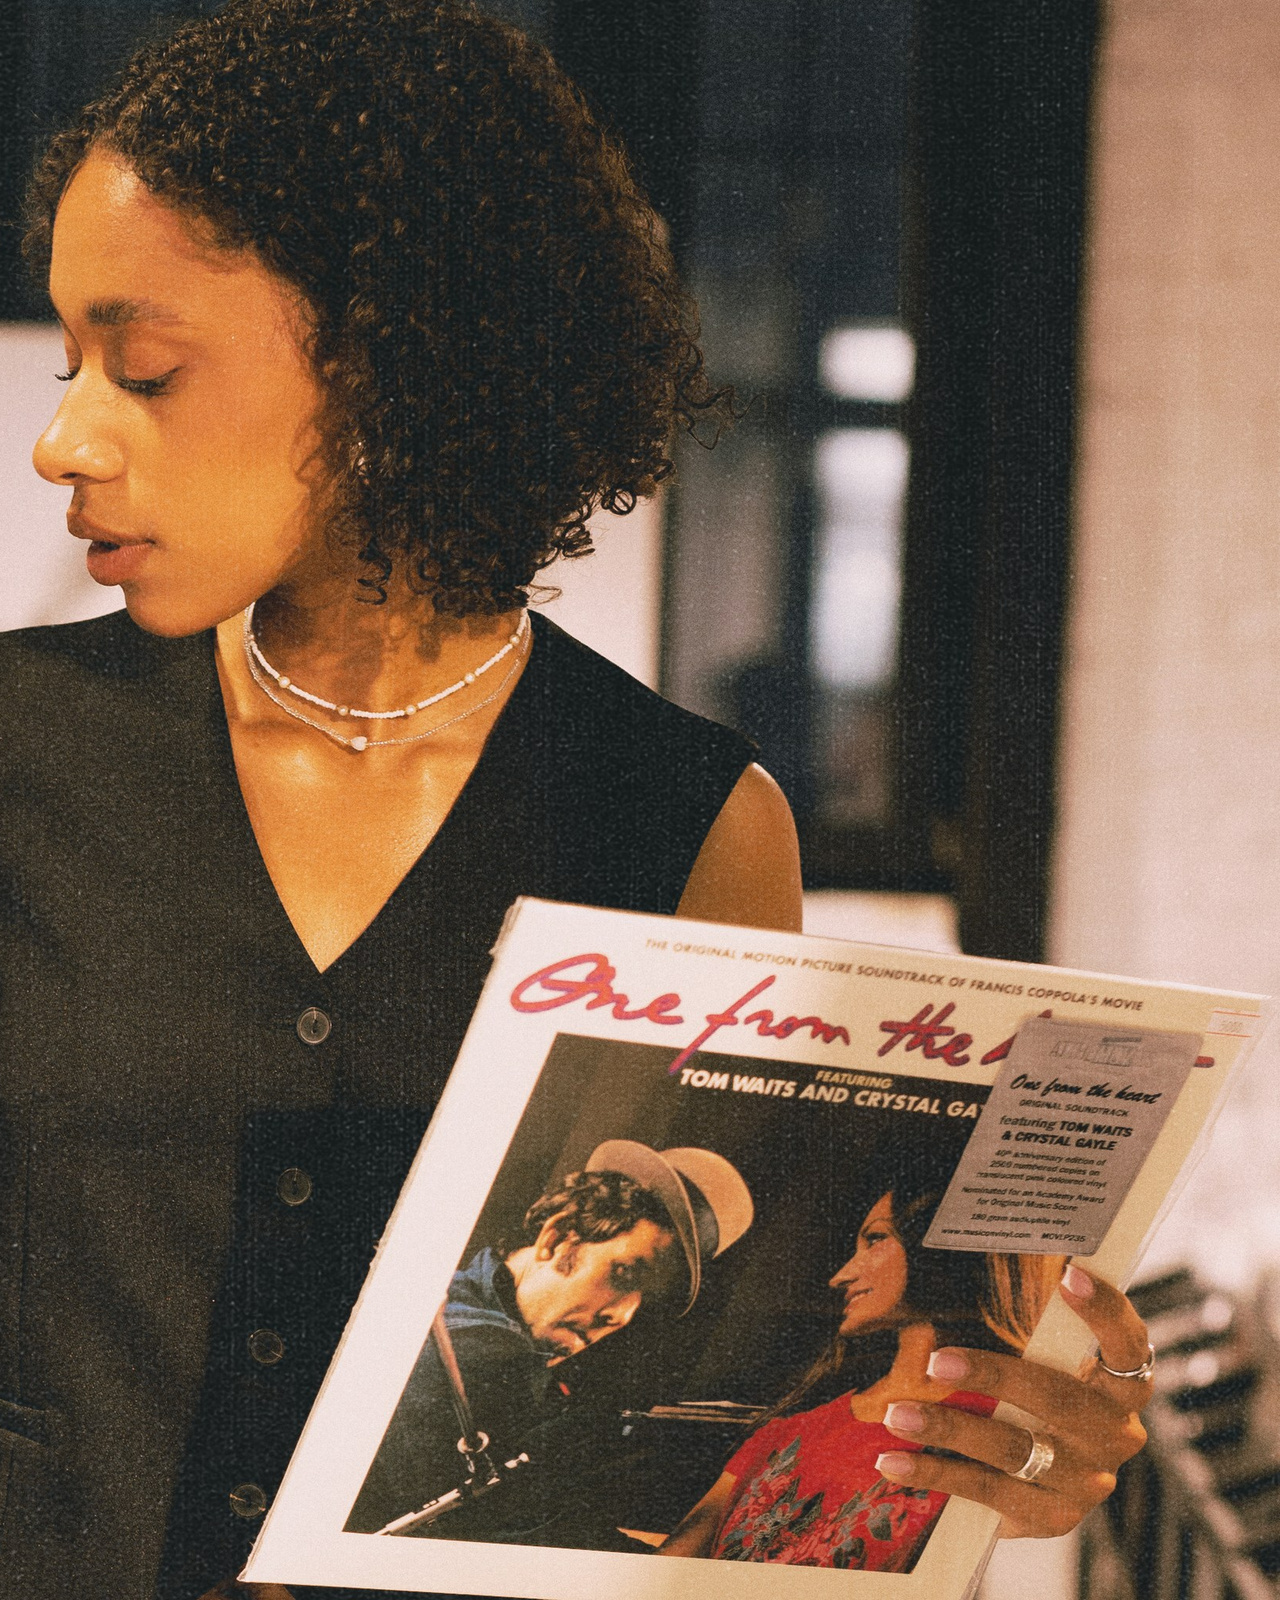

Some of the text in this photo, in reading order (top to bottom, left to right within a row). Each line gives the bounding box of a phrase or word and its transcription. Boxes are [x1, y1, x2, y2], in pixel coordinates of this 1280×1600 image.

[646, 938, 1144, 1012] THE ORIGINAL MOTION PICTURE SOUNDTRACK OF FRANCIS COPPOLA'S MOVIE
[510, 953, 684, 1025] One
[668, 974, 850, 1075] from
[878, 1001, 972, 1067] the
[815, 1070, 893, 1089] FEATURING
[679, 1068, 729, 1090] TOM
[732, 1074, 797, 1098] WAITS
[799, 1083, 850, 1103] AND
[854, 1090, 941, 1115] CRYSTAL
[1010, 1073, 1162, 1105] One from the heart
[1019, 1099, 1130, 1117] ORIGINAL SOUNDTRACK
[999, 1115, 1135, 1137] featuring TOM WAITS
[1001, 1130, 1118, 1151] & CRYSTAL GAYLE
[1013, 1151, 1063, 1163] anniversary
[1065, 1156, 1096, 1166] edition
[1013, 1162, 1058, 1173] numbered
[1059, 1165, 1087, 1176] copies
[1047, 1175, 1085, 1186] coloured
[1085, 1179, 1108, 1189] vinyl
[962, 1186, 1007, 1195] Nominated
[1008, 1188, 1021, 1196] for
[1035, 1190, 1075, 1202] Academy
[1075, 1194, 1106, 1204] Award
[976, 1197, 1079, 1212] for Original Music Score
[970, 1213, 986, 1221] 180
[987, 1215, 1009, 1223] gram
[1051, 1218, 1070, 1227] vinyl
